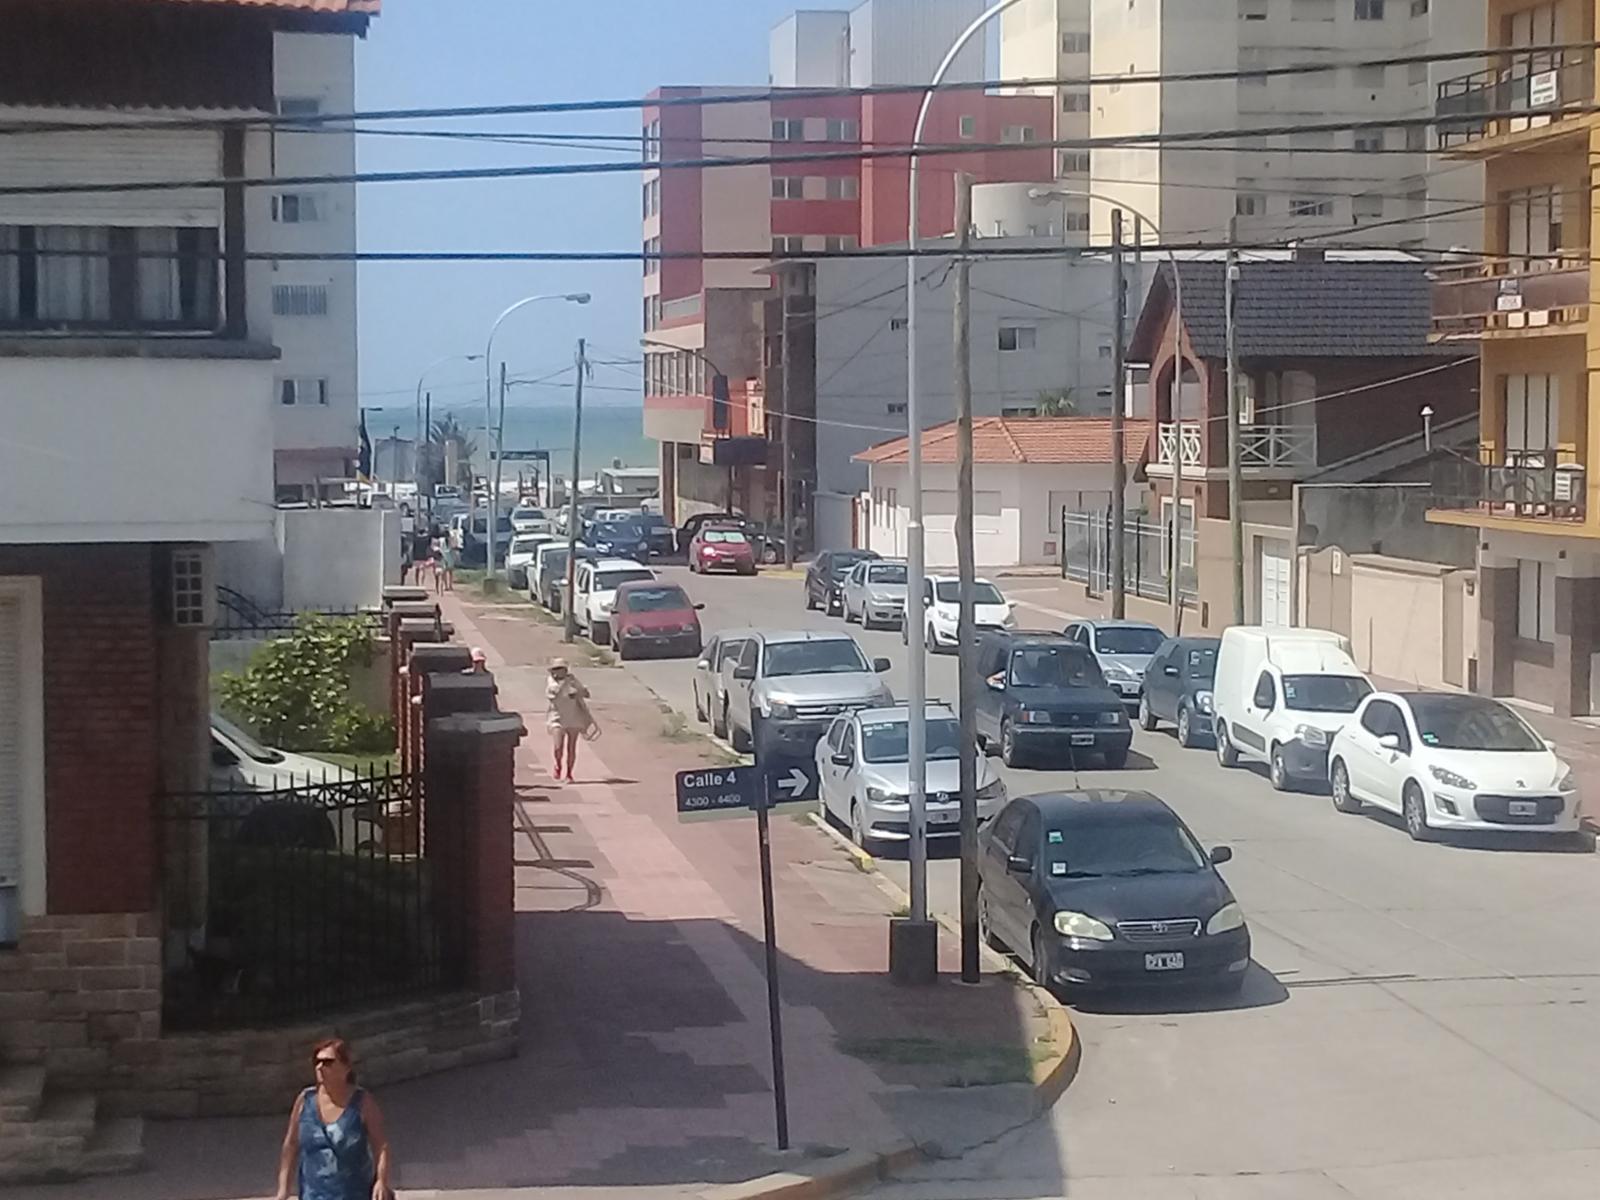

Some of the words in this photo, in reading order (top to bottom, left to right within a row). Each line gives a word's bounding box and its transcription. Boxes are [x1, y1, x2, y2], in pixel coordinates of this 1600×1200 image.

[683, 773, 723, 788] Calle
[726, 771, 737, 784] 4
[685, 796, 710, 807] 4300
